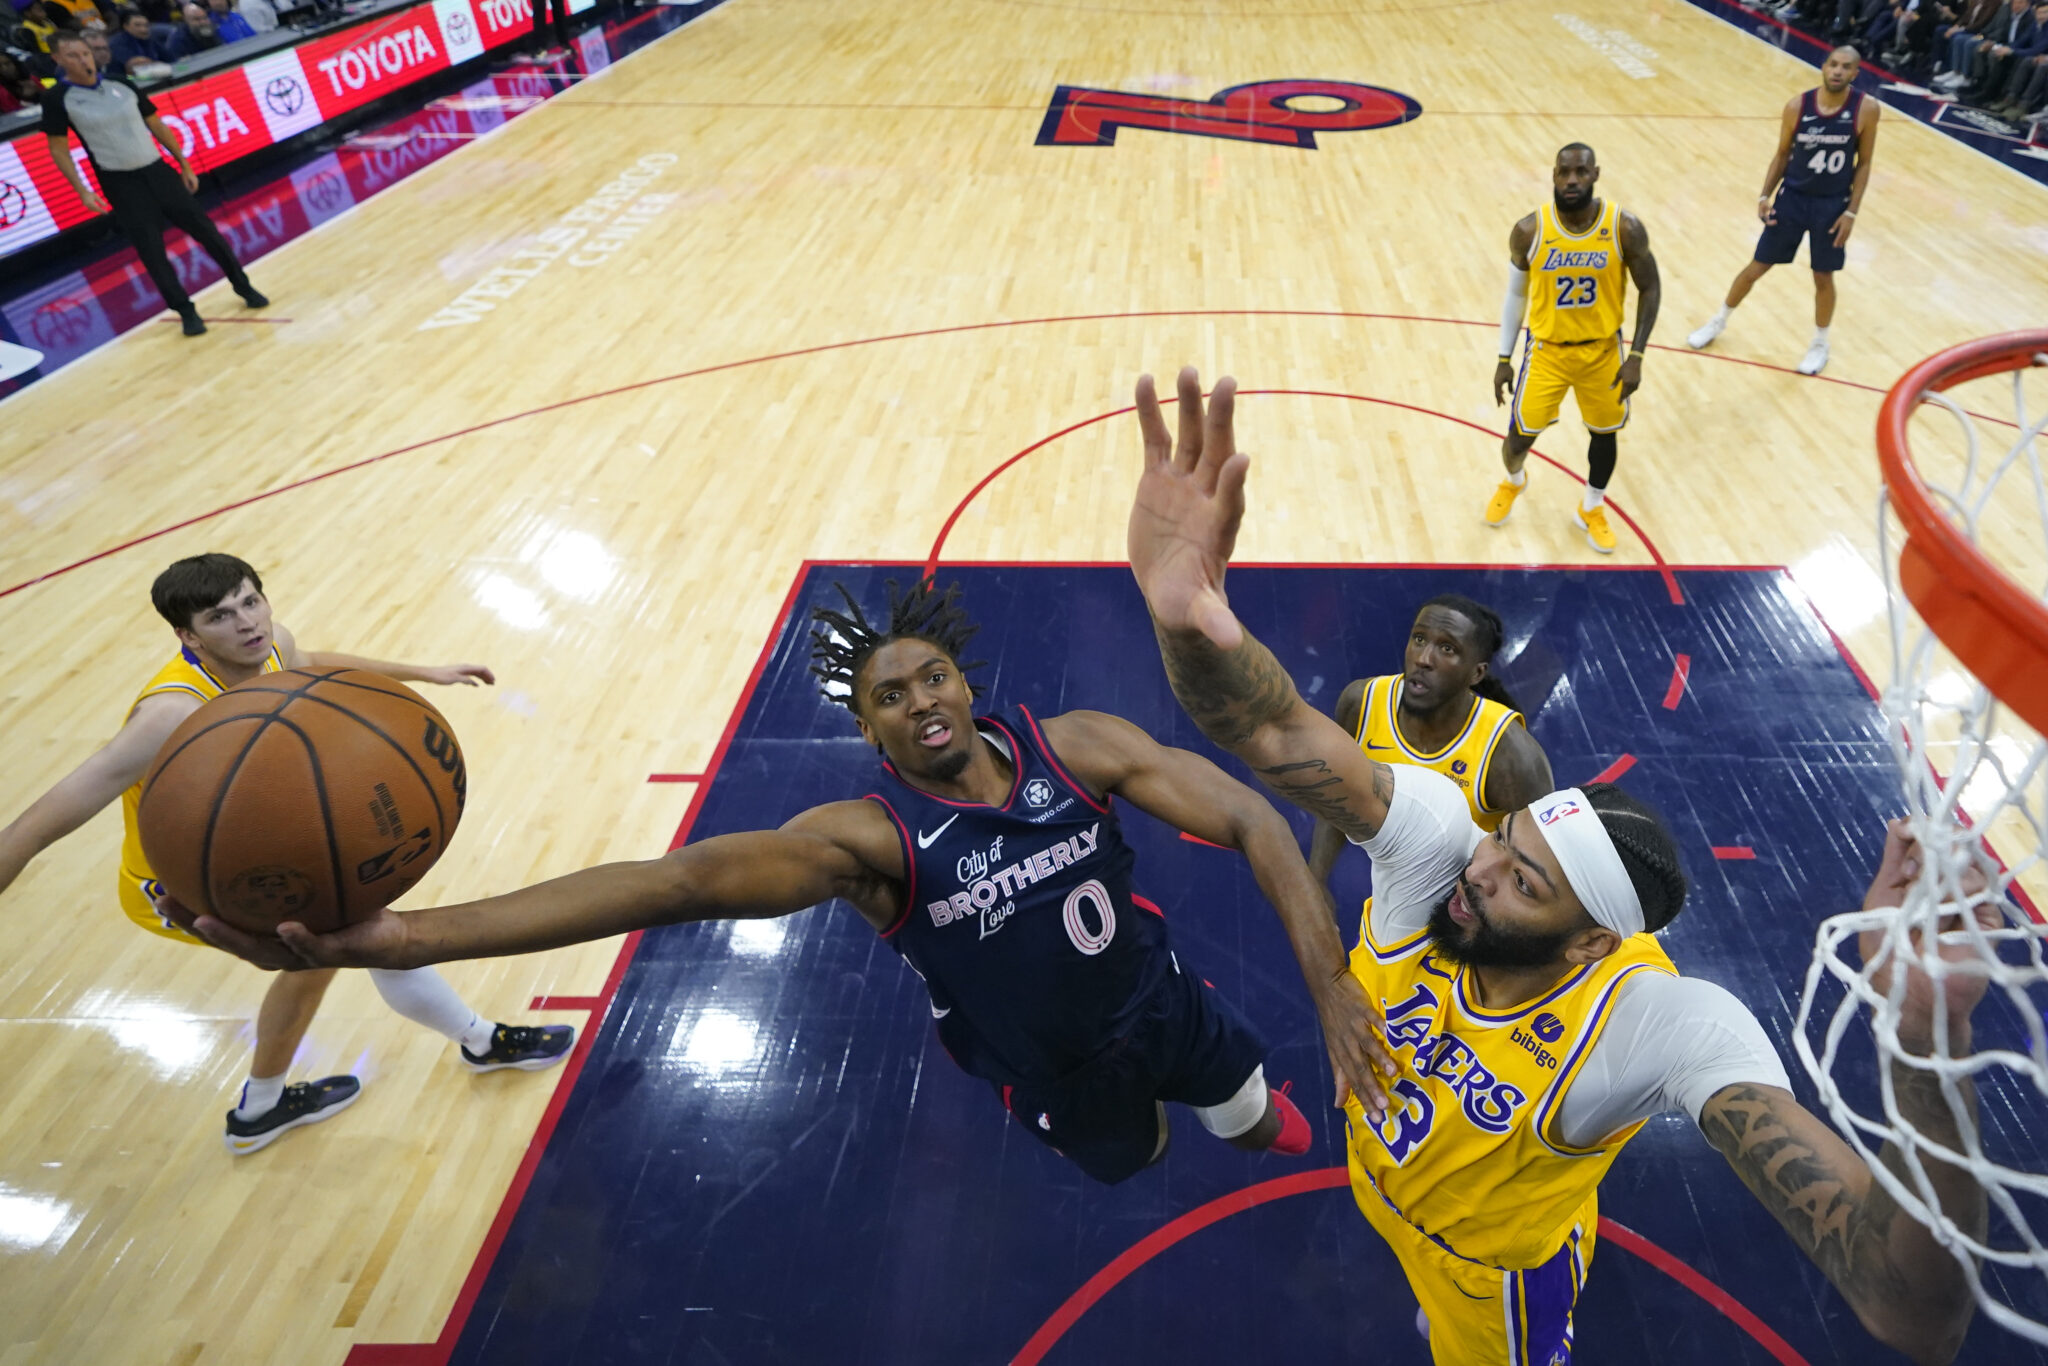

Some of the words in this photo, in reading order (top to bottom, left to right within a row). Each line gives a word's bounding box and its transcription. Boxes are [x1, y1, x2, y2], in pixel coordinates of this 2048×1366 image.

[318, 25, 436, 96] TOYOTA
[1807, 149, 1846, 174] 40
[418, 227, 588, 331] WELLS
[1541, 248, 1608, 272] LAKERS
[1556, 276, 1597, 309] 23
[927, 822, 1099, 928] BROTHERLY
[956, 850, 988, 890] City
[990, 835, 1003, 863] of
[979, 900, 1015, 941] Love
[1062, 879, 1116, 955] 0
[1510, 1027, 1558, 1070] bibigo
